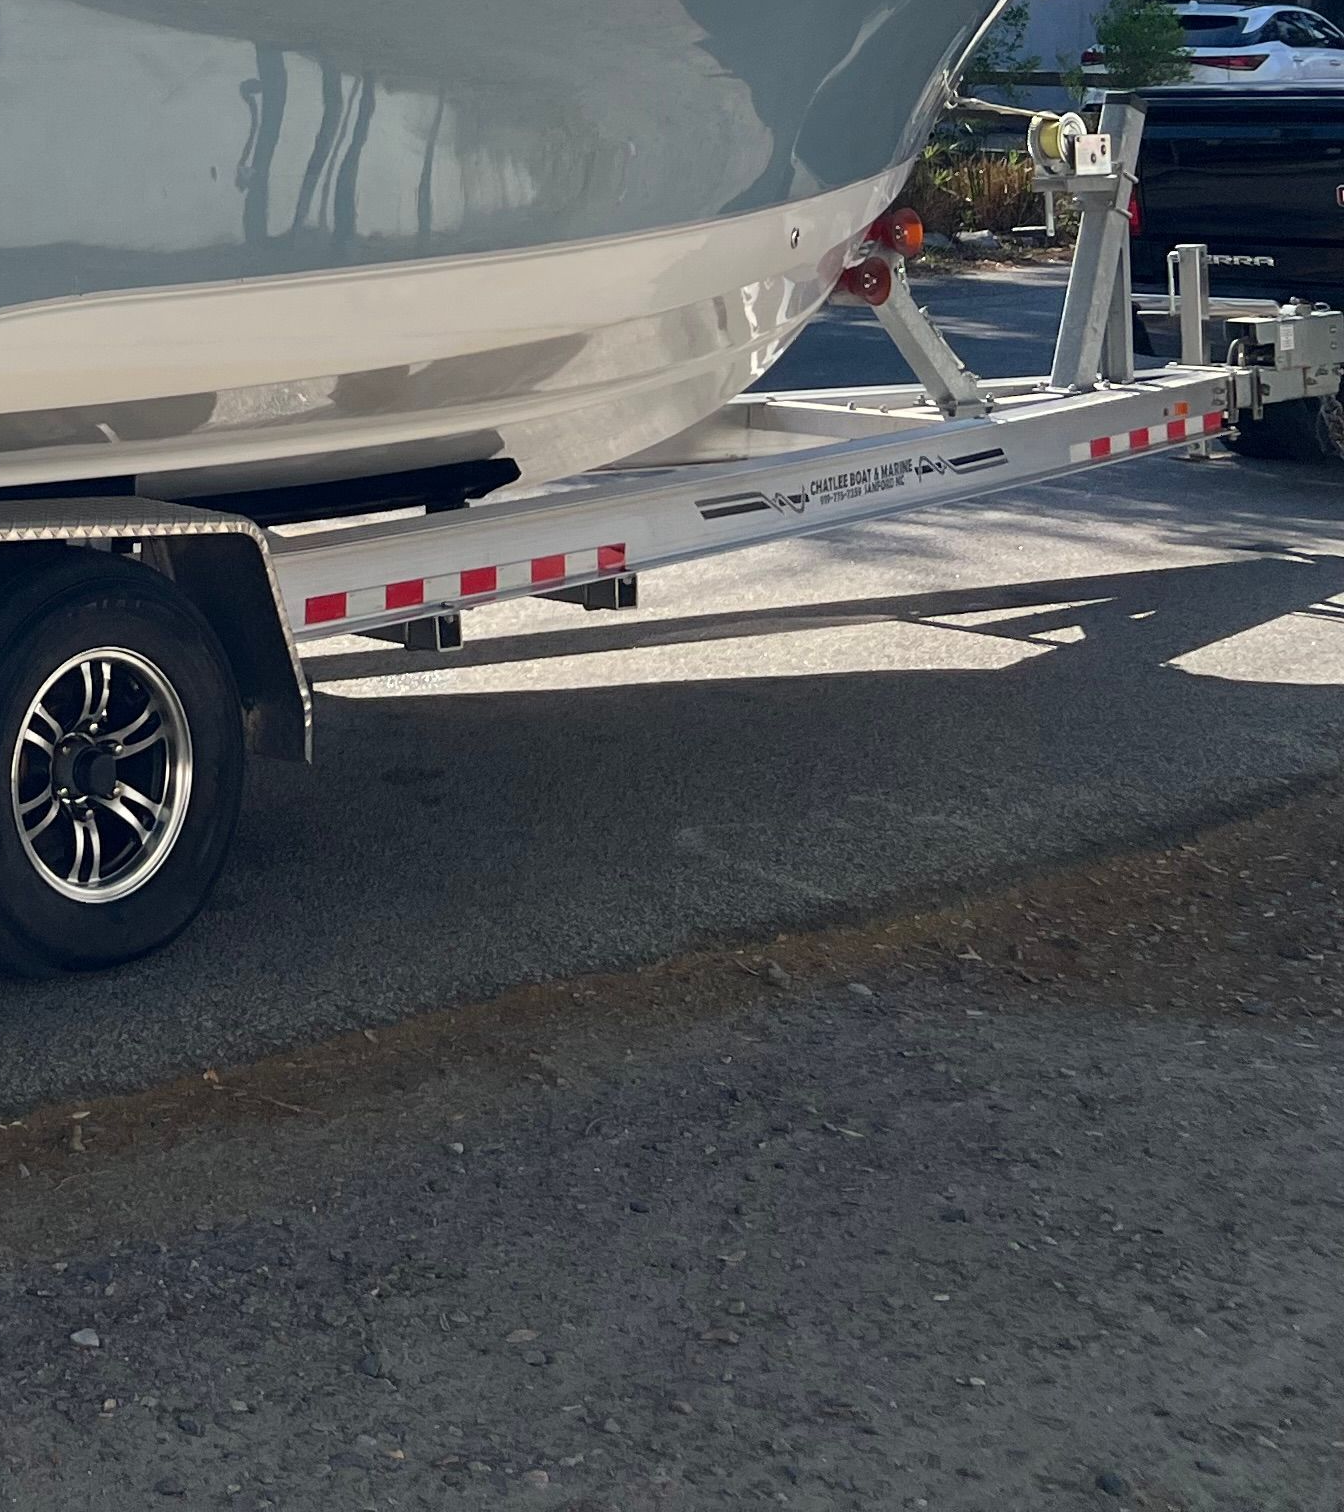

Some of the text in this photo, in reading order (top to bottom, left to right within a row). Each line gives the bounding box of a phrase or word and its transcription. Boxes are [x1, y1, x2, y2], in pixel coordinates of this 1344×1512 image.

[810, 458, 912, 496] CHATLEE BOAT & MARINE
